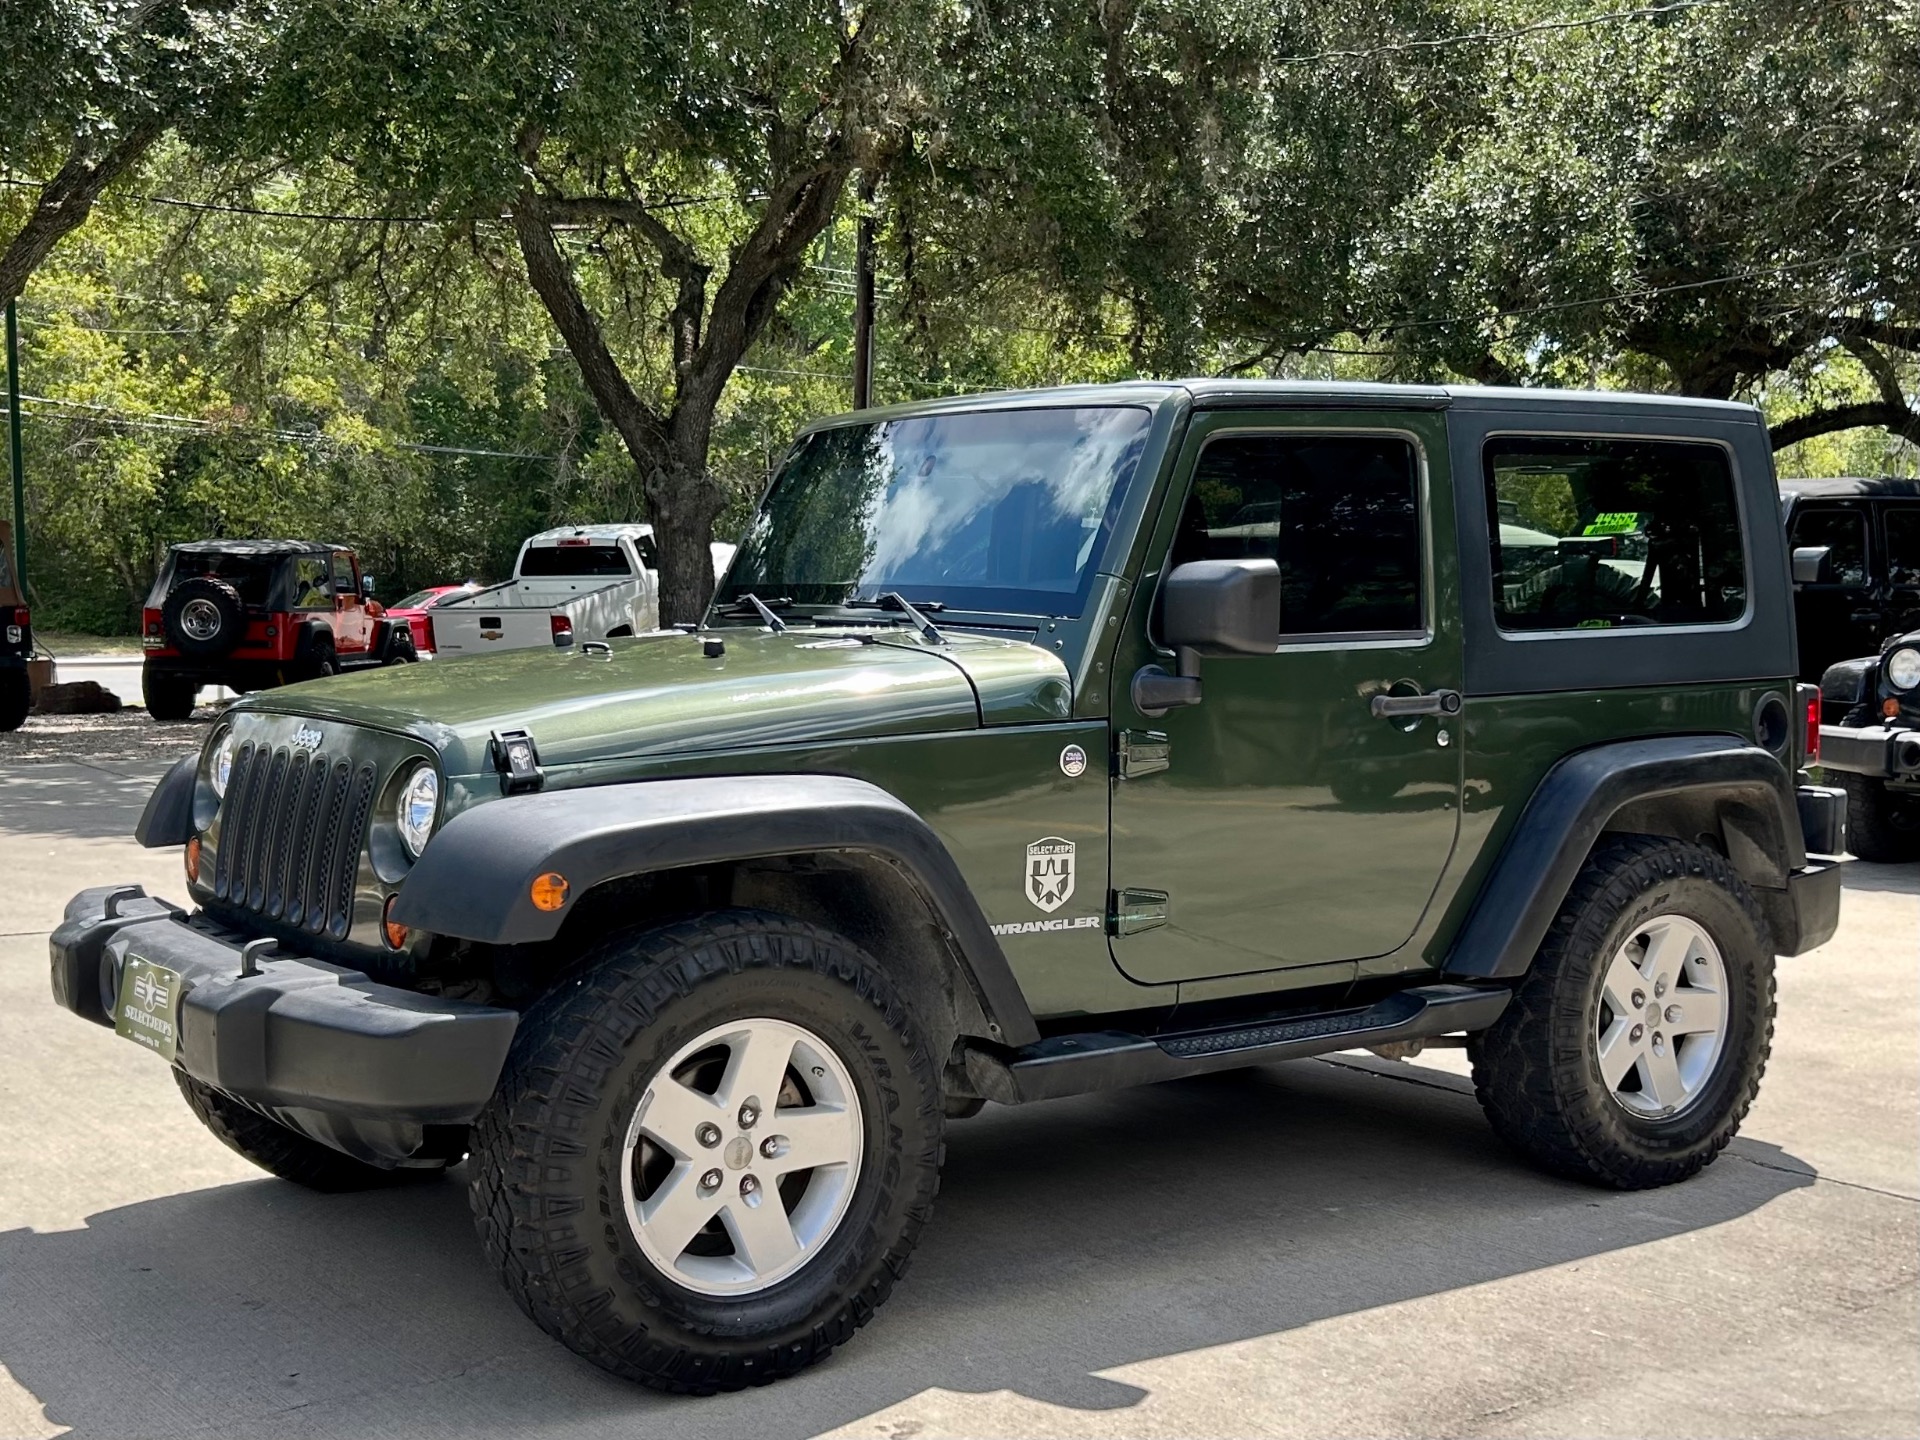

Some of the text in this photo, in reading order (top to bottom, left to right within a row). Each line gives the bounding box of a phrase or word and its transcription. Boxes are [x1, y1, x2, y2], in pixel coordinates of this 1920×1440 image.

[292, 723, 323, 753] Jeep
[990, 916, 1100, 936] WRANGLER
[834, 1019, 904, 1288] WRANGLER
